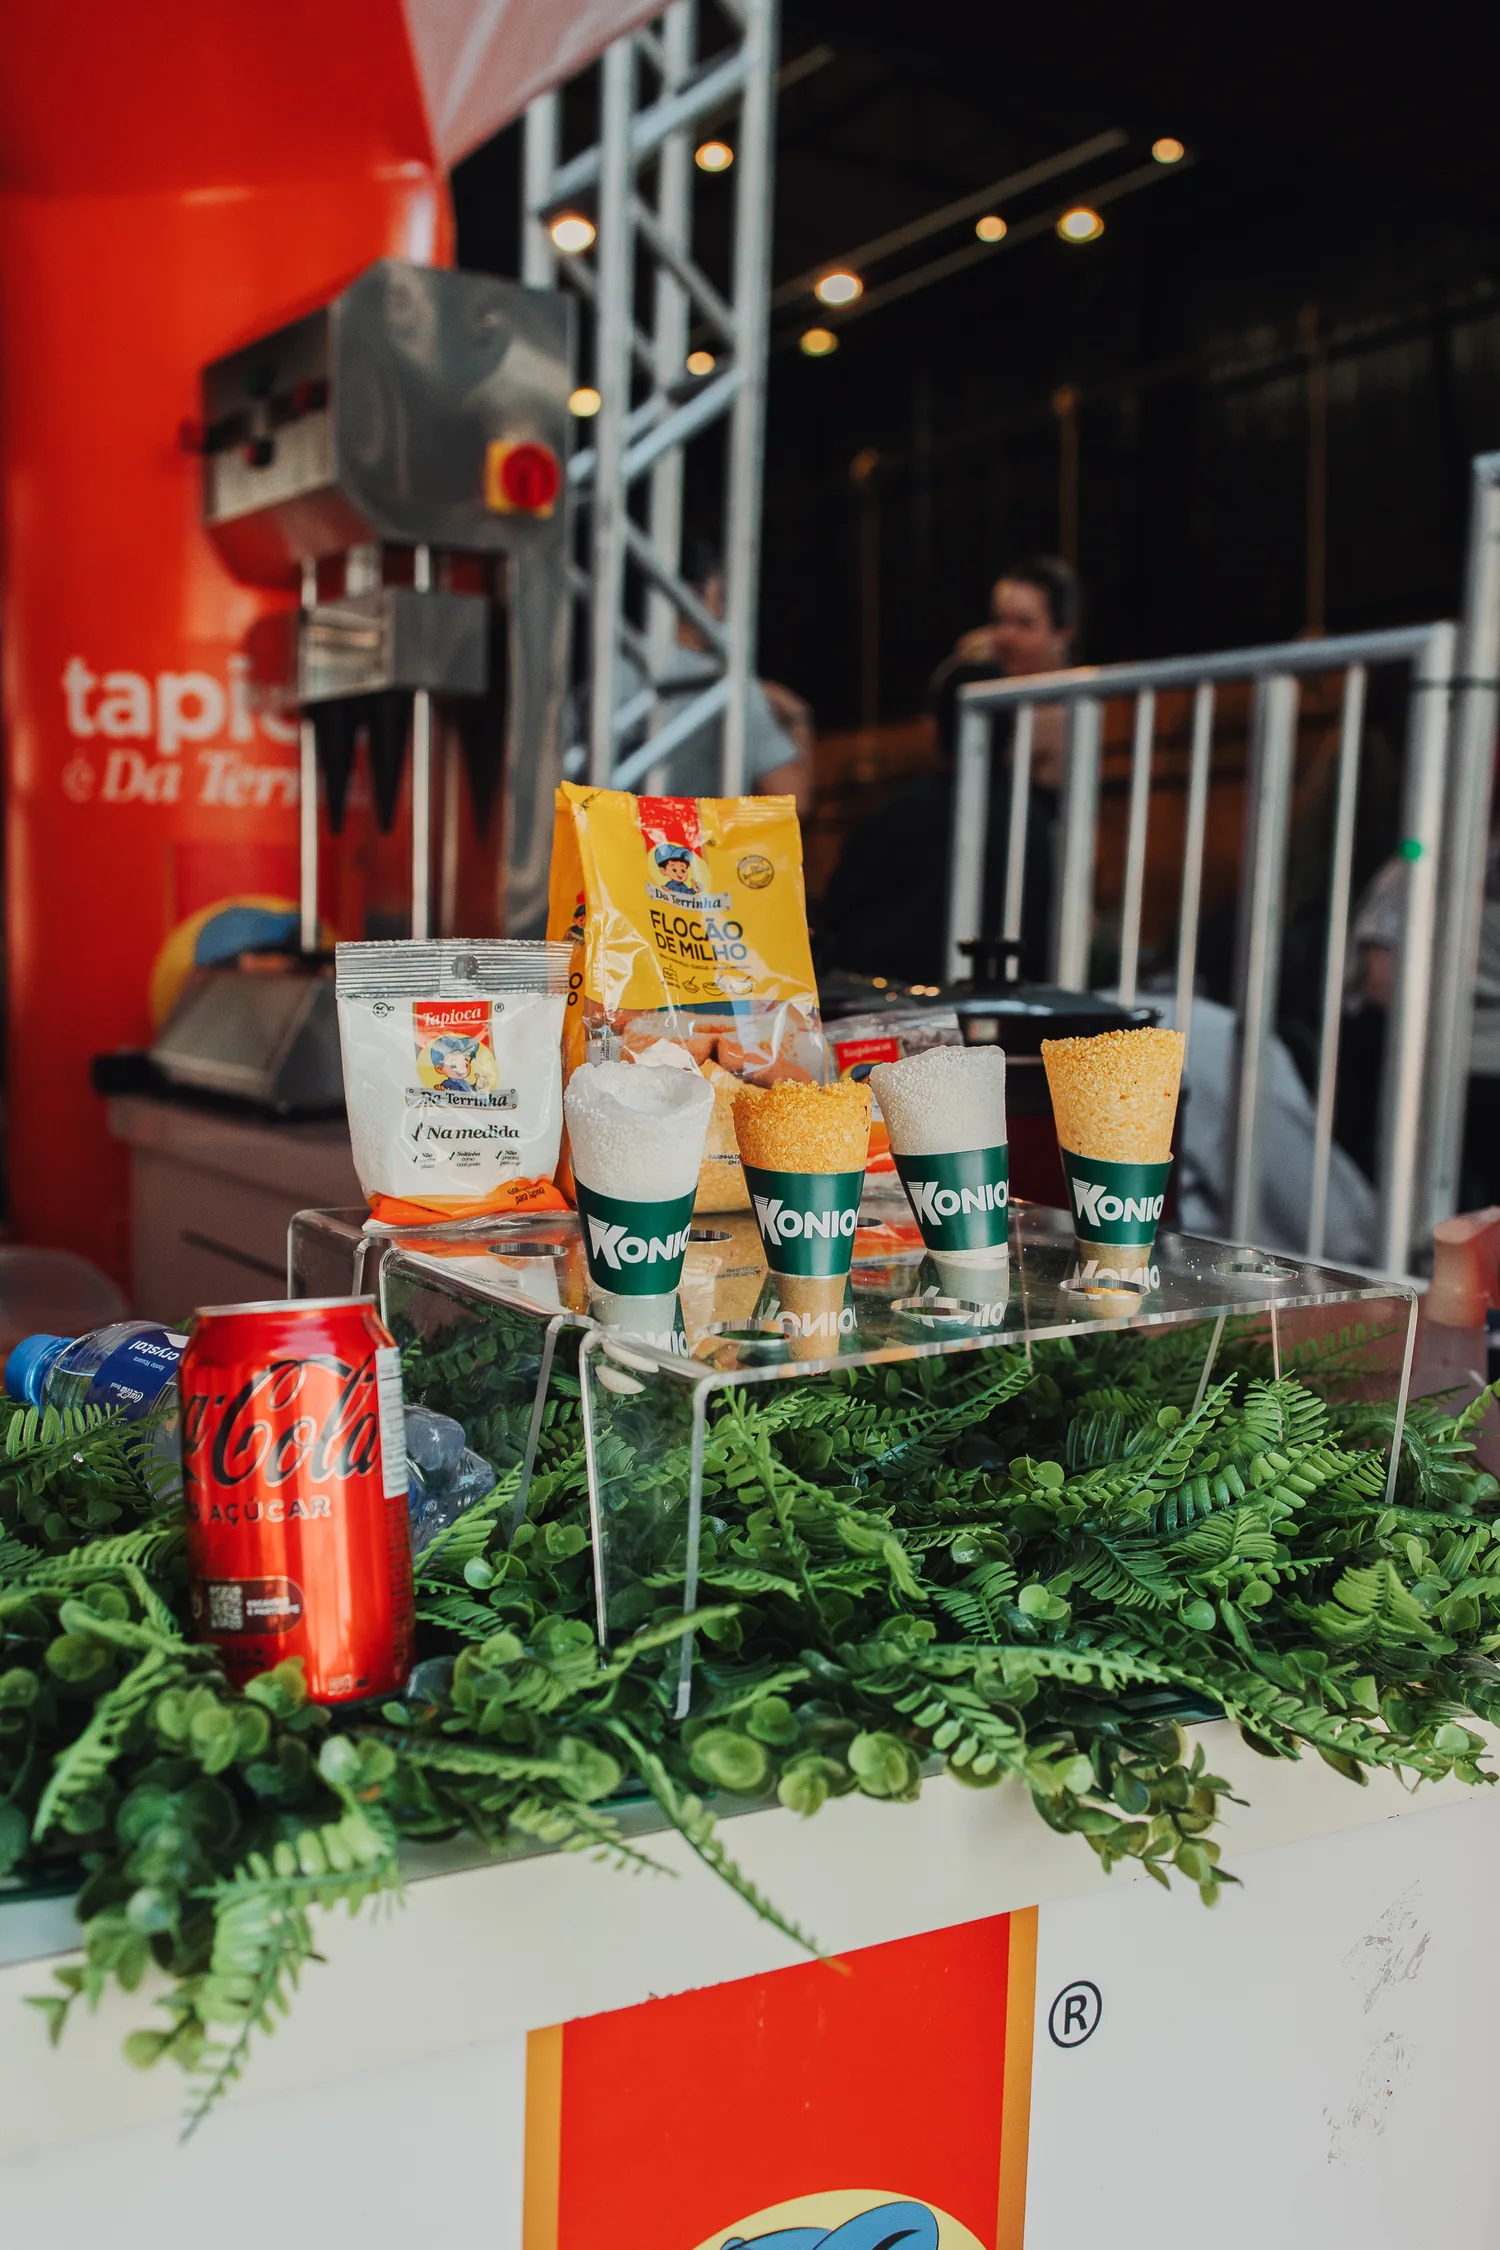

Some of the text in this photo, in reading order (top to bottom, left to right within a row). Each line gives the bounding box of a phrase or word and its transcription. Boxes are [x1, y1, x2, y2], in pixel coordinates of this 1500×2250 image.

[102, 749, 181, 804] Da
[655, 888, 721, 909] Da Terrinha
[650, 909, 743, 941] FLOCÃO
[655, 931, 677, 955] DE
[679, 940, 747, 961] MILHO
[422, 1007, 481, 1029] Tapioca
[446, 1092, 507, 1107] Terrinha
[426, 1125, 520, 1140] Na medida
[906, 1179, 1009, 1226] KONIO
[753, 1194, 860, 1246] KONIO
[128, 1340, 180, 1361] crystal
[210, 1494, 332, 1526] AÇÚCAR
